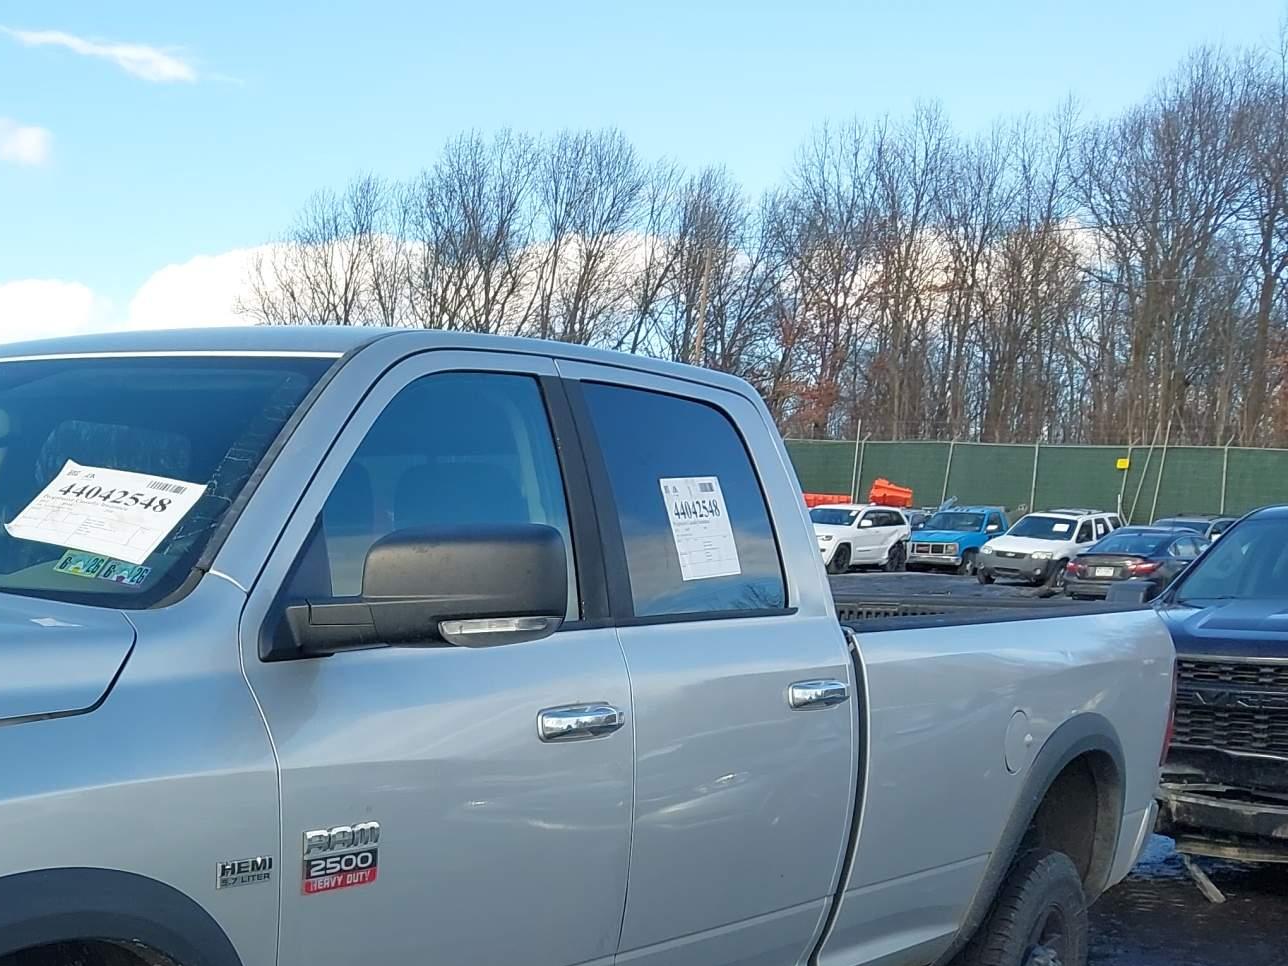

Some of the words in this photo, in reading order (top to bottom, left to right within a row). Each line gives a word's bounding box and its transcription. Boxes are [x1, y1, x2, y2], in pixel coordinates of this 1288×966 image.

[59, 483, 172, 512] 44042548
[674, 499, 721, 519] 44042548
[59, 556, 73, 570] 6
[103, 564, 117, 578] 6
[129, 567, 149, 584] 26
[305, 821, 380, 854] RAM
[220, 856, 273, 877] HEMI
[310, 852, 373, 877] 2500
[221, 876, 238, 887] 5.7
[241, 872, 271, 884] LITER
[311, 876, 344, 891] HEAVY
[346, 869, 371, 885] DUTY
